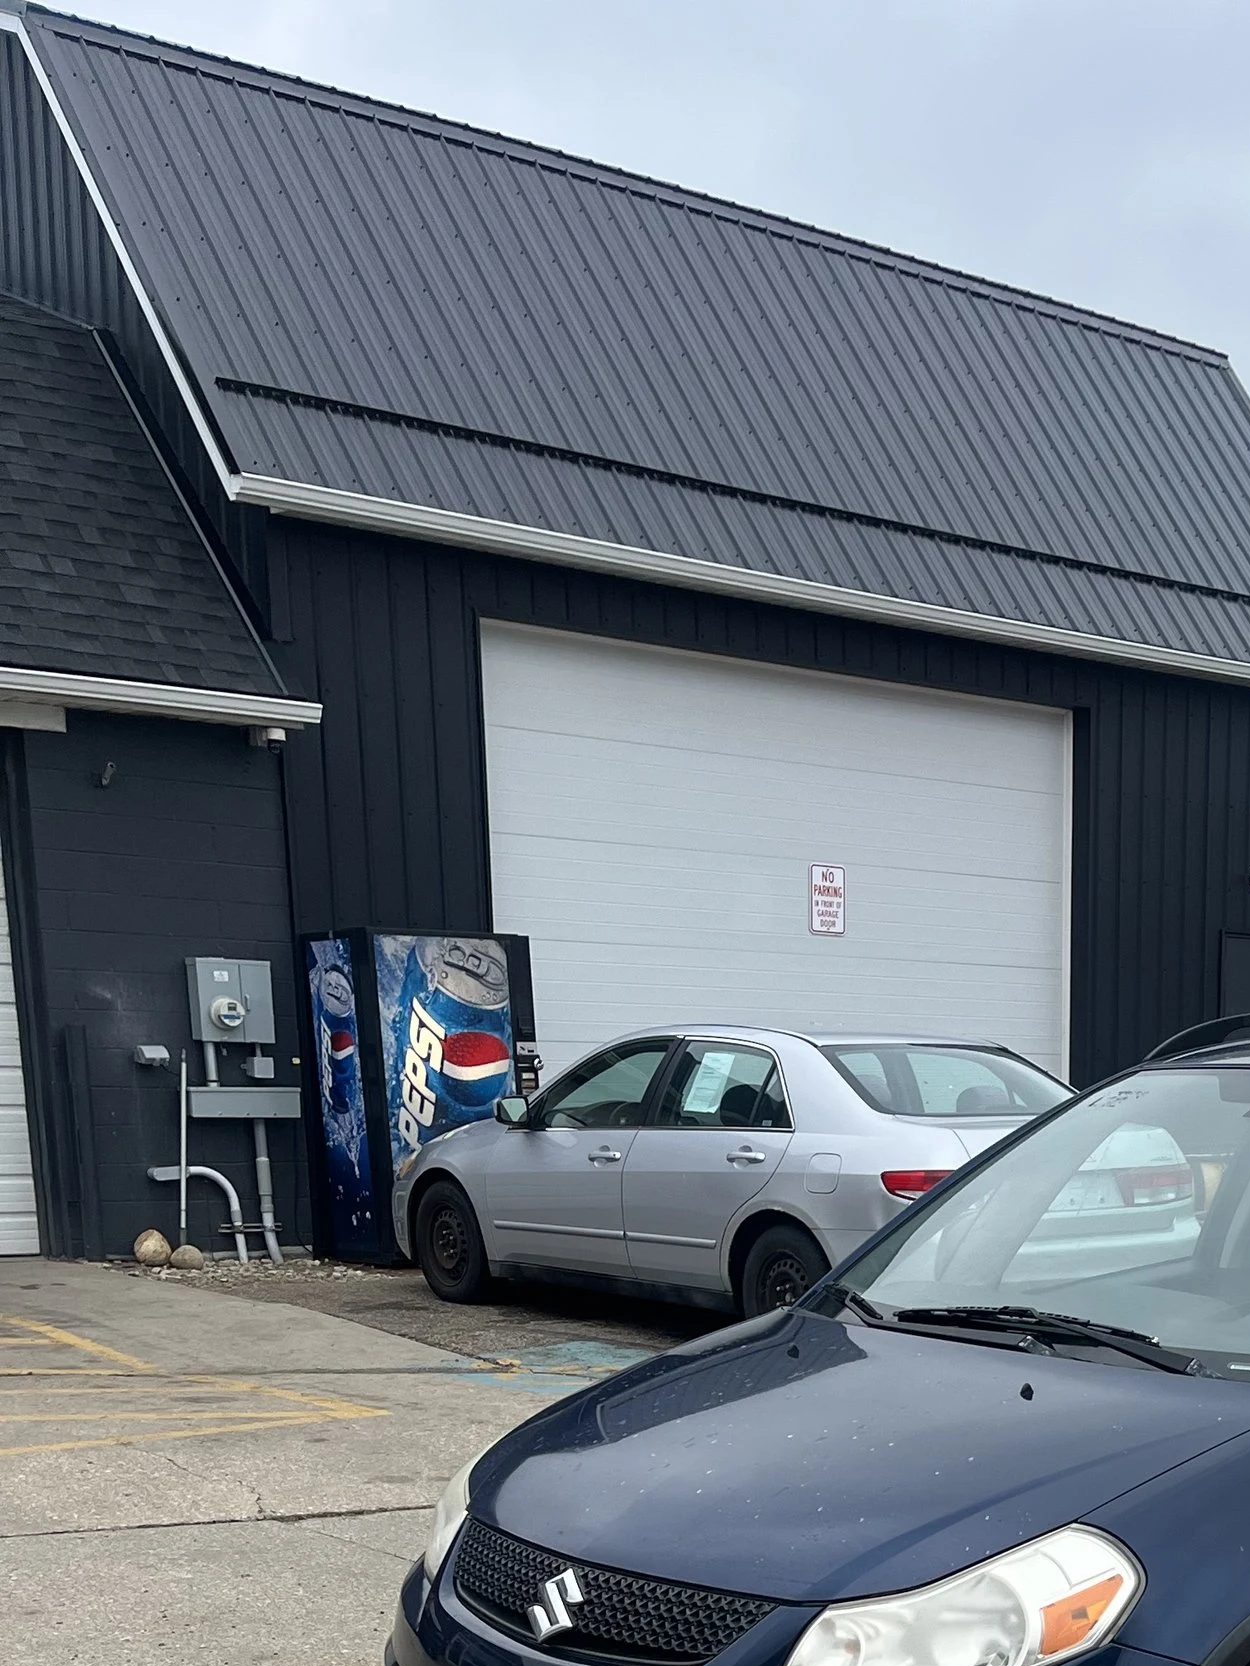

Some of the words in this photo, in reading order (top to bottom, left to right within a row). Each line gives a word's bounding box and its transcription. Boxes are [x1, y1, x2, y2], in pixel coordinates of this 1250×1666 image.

[821, 871, 835, 883] NO
[813, 884, 843, 898] PARKING
[817, 909, 840, 919] GARAGE
[820, 919, 836, 928] DOOR
[320, 1015, 333, 1106] PEPSI
[398, 996, 446, 1151] PEPSI
